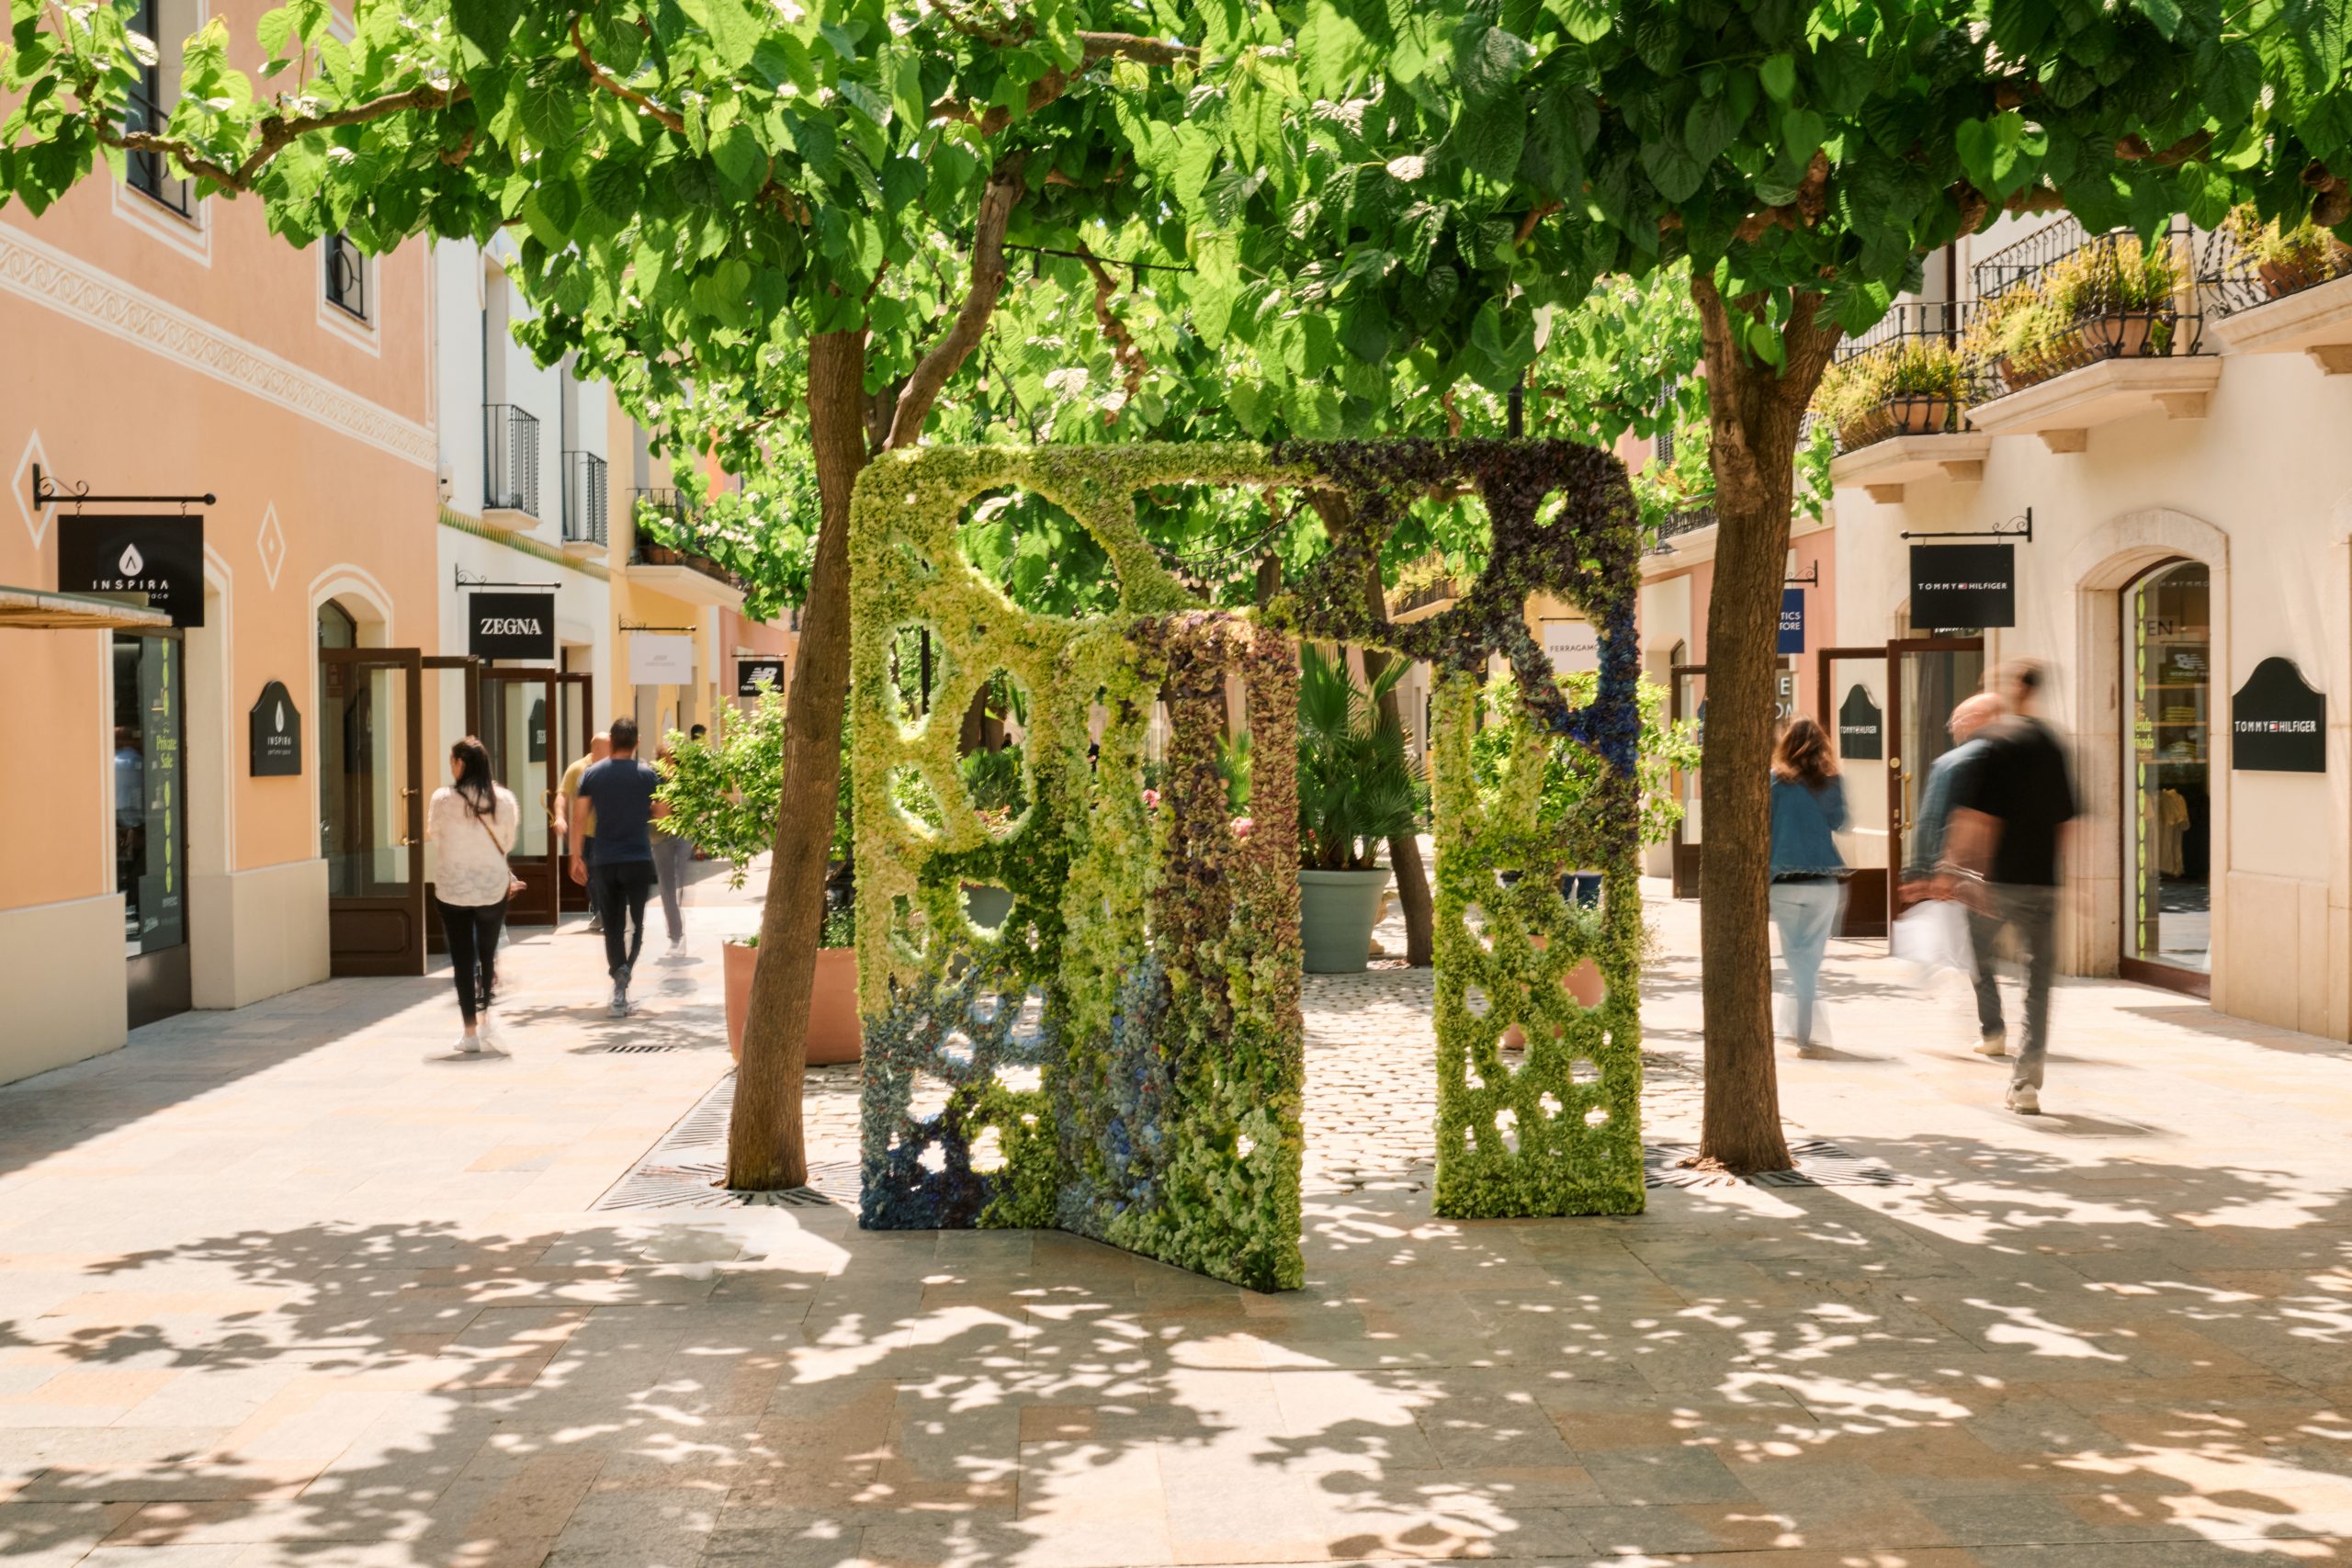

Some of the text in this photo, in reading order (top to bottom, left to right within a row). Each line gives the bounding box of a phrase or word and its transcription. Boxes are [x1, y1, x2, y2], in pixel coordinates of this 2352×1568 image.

[93, 580, 170, 590] INSPIRA
[1781, 611, 1801, 621] TICS
[481, 618, 543, 636] ZEGNA
[1779, 621, 1801, 631] TORE
[1549, 645, 1600, 653] FERRAGAMO
[2234, 720, 2316, 733] TOMMY HILFIGER
[156, 734, 177, 751] Private
[267, 736, 292, 746] INSPIRA
[160, 751, 174, 770] Sale
